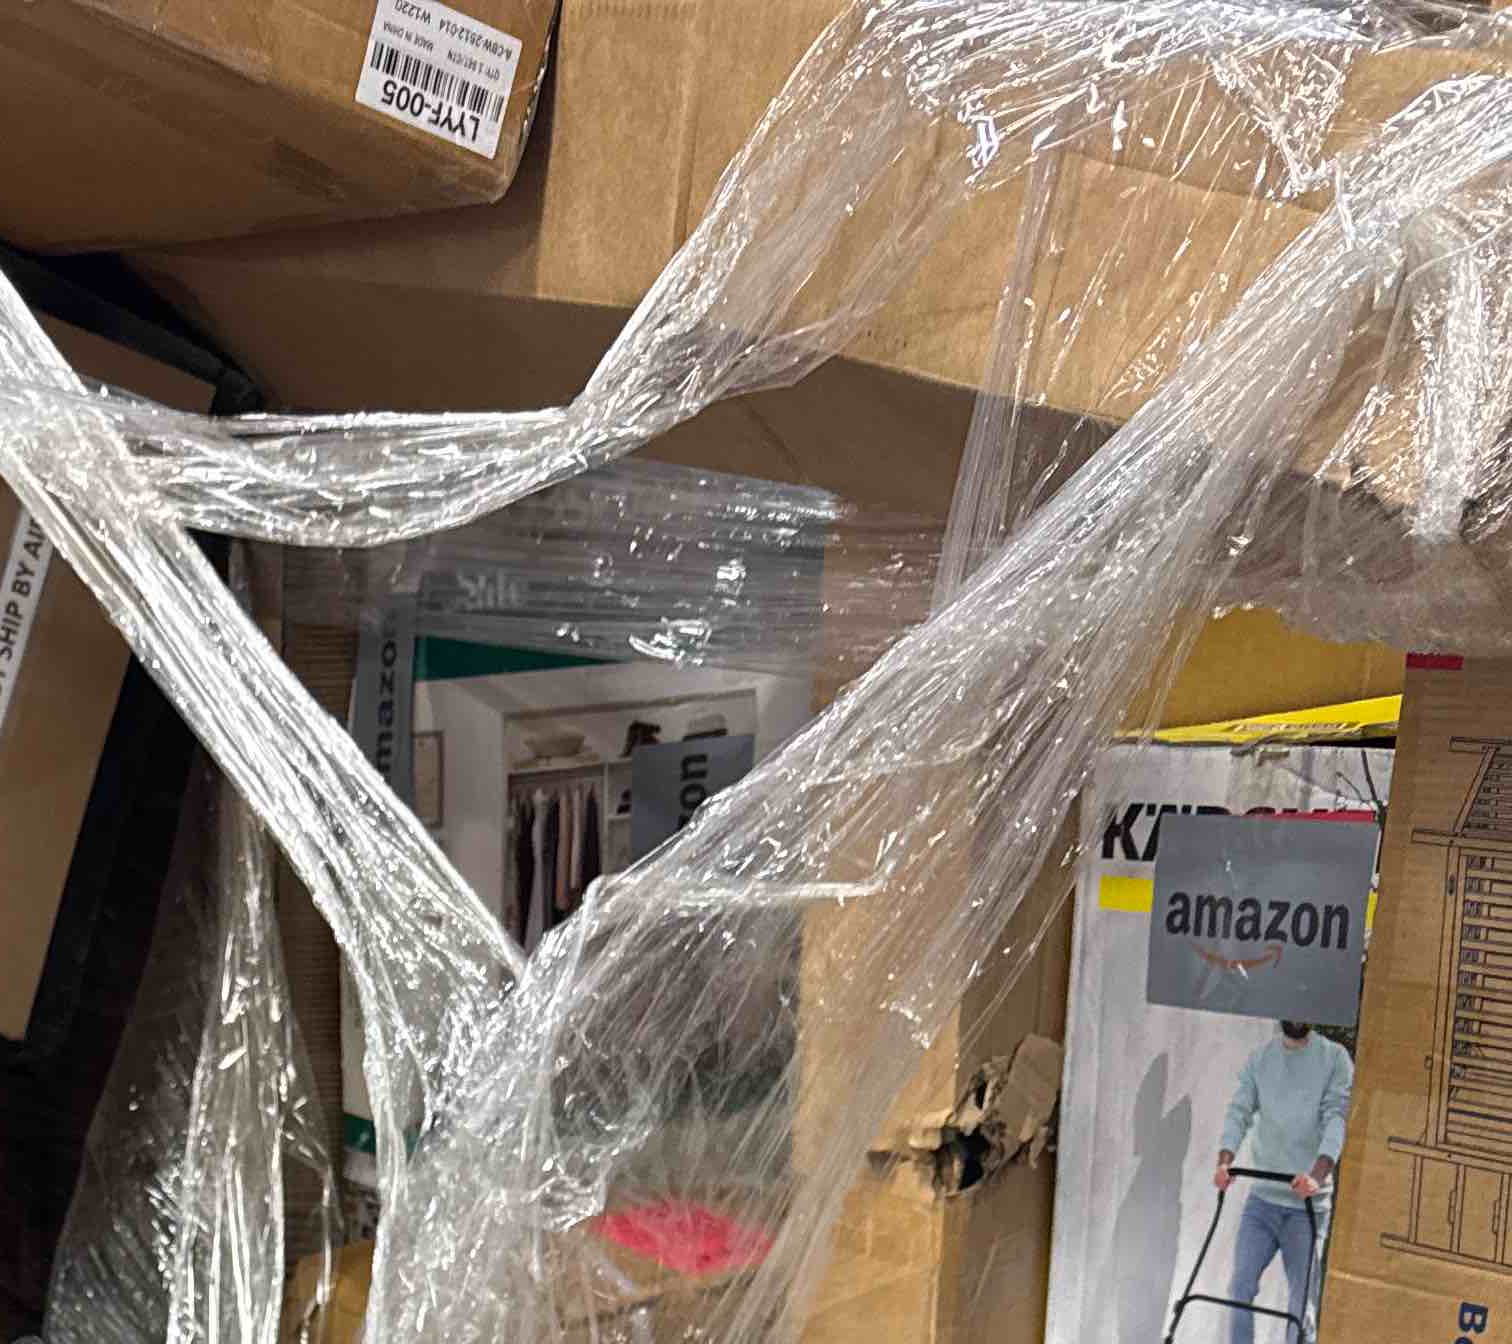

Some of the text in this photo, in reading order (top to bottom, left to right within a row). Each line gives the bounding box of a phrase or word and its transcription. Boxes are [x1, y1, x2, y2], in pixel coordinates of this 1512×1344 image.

[381, 80, 480, 142] LYYF-005
[10, 560, 38, 598] BY
[1165, 888, 1349, 950] amazon
